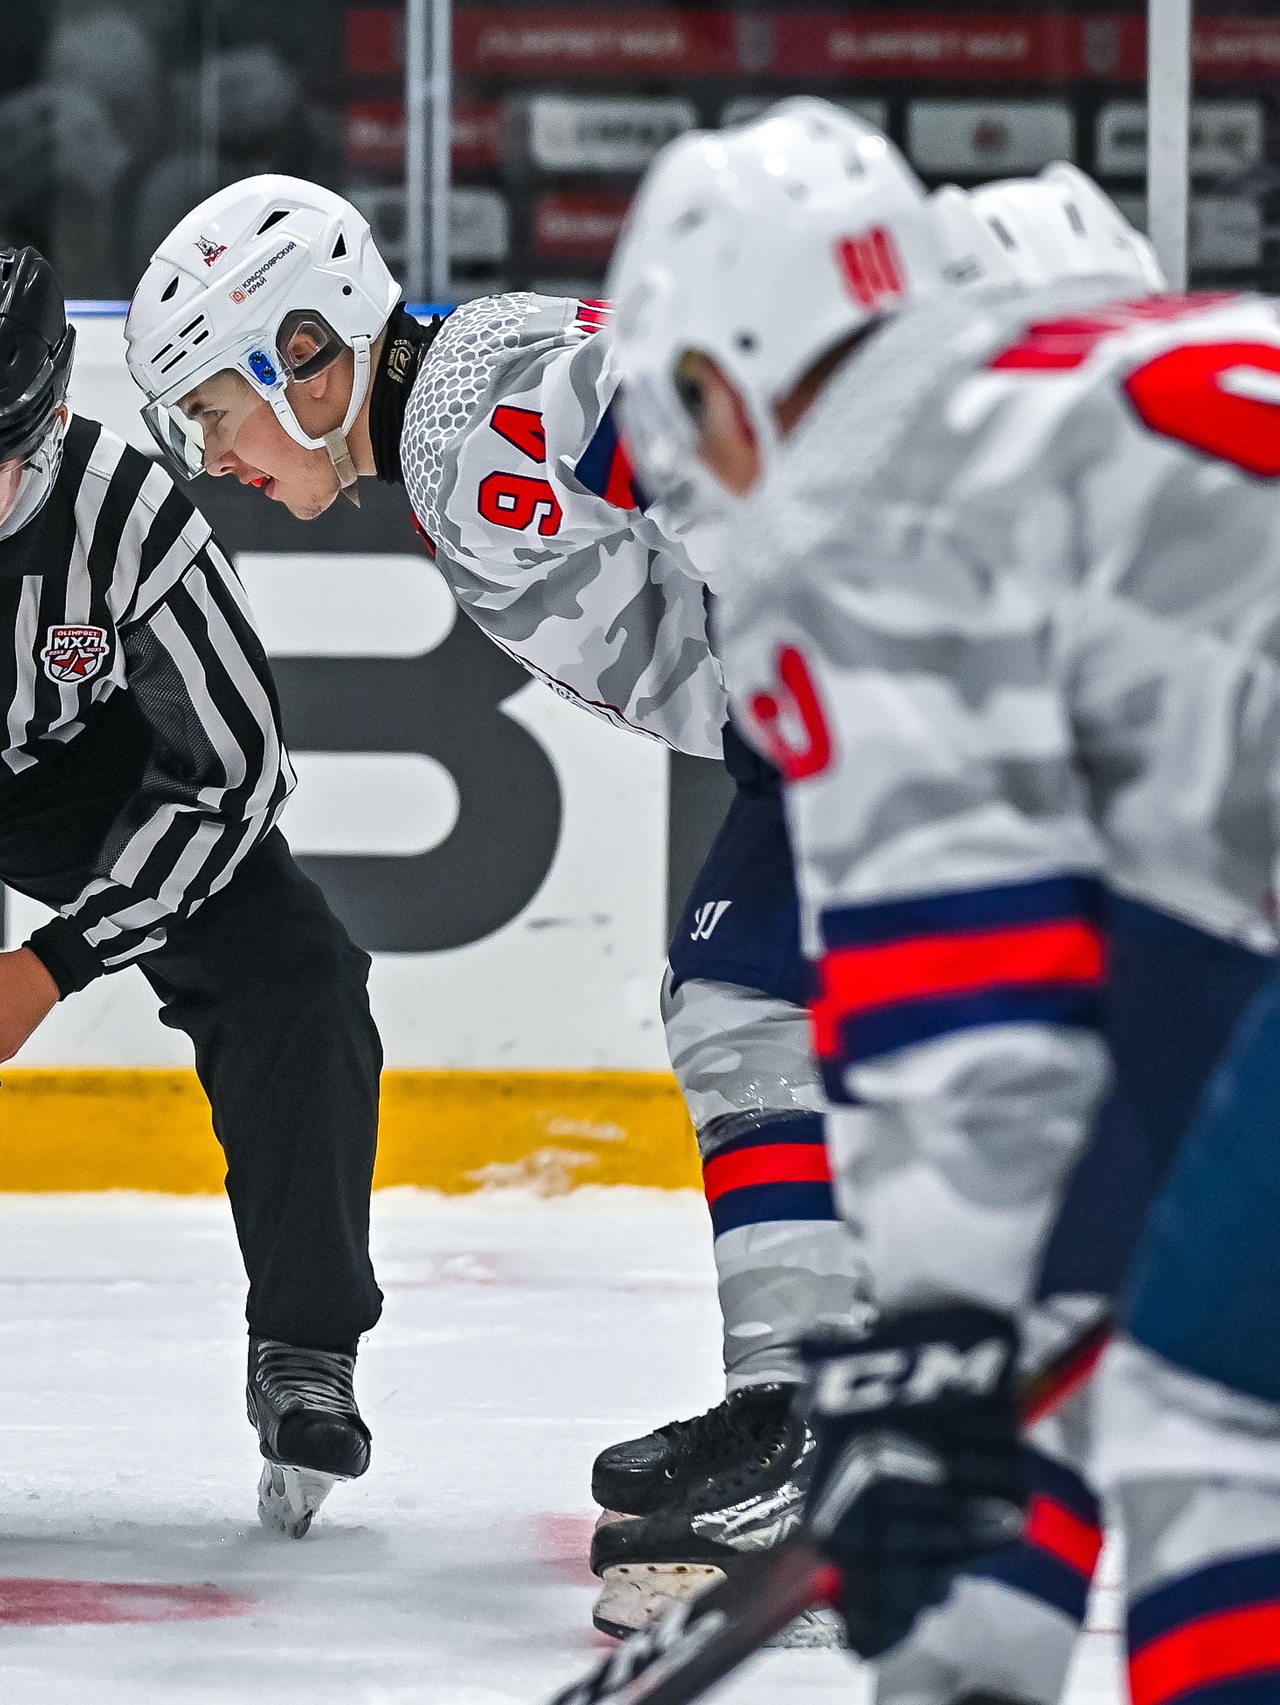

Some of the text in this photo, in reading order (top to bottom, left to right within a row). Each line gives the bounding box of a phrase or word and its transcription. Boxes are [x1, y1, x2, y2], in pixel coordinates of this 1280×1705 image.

[241, 240, 298, 290] КРАСНОЯРСКИЙ
[246, 276, 268, 296] КРАЙ
[477, 404, 564, 537] 94
[54, 637, 100, 649] МХЛ
